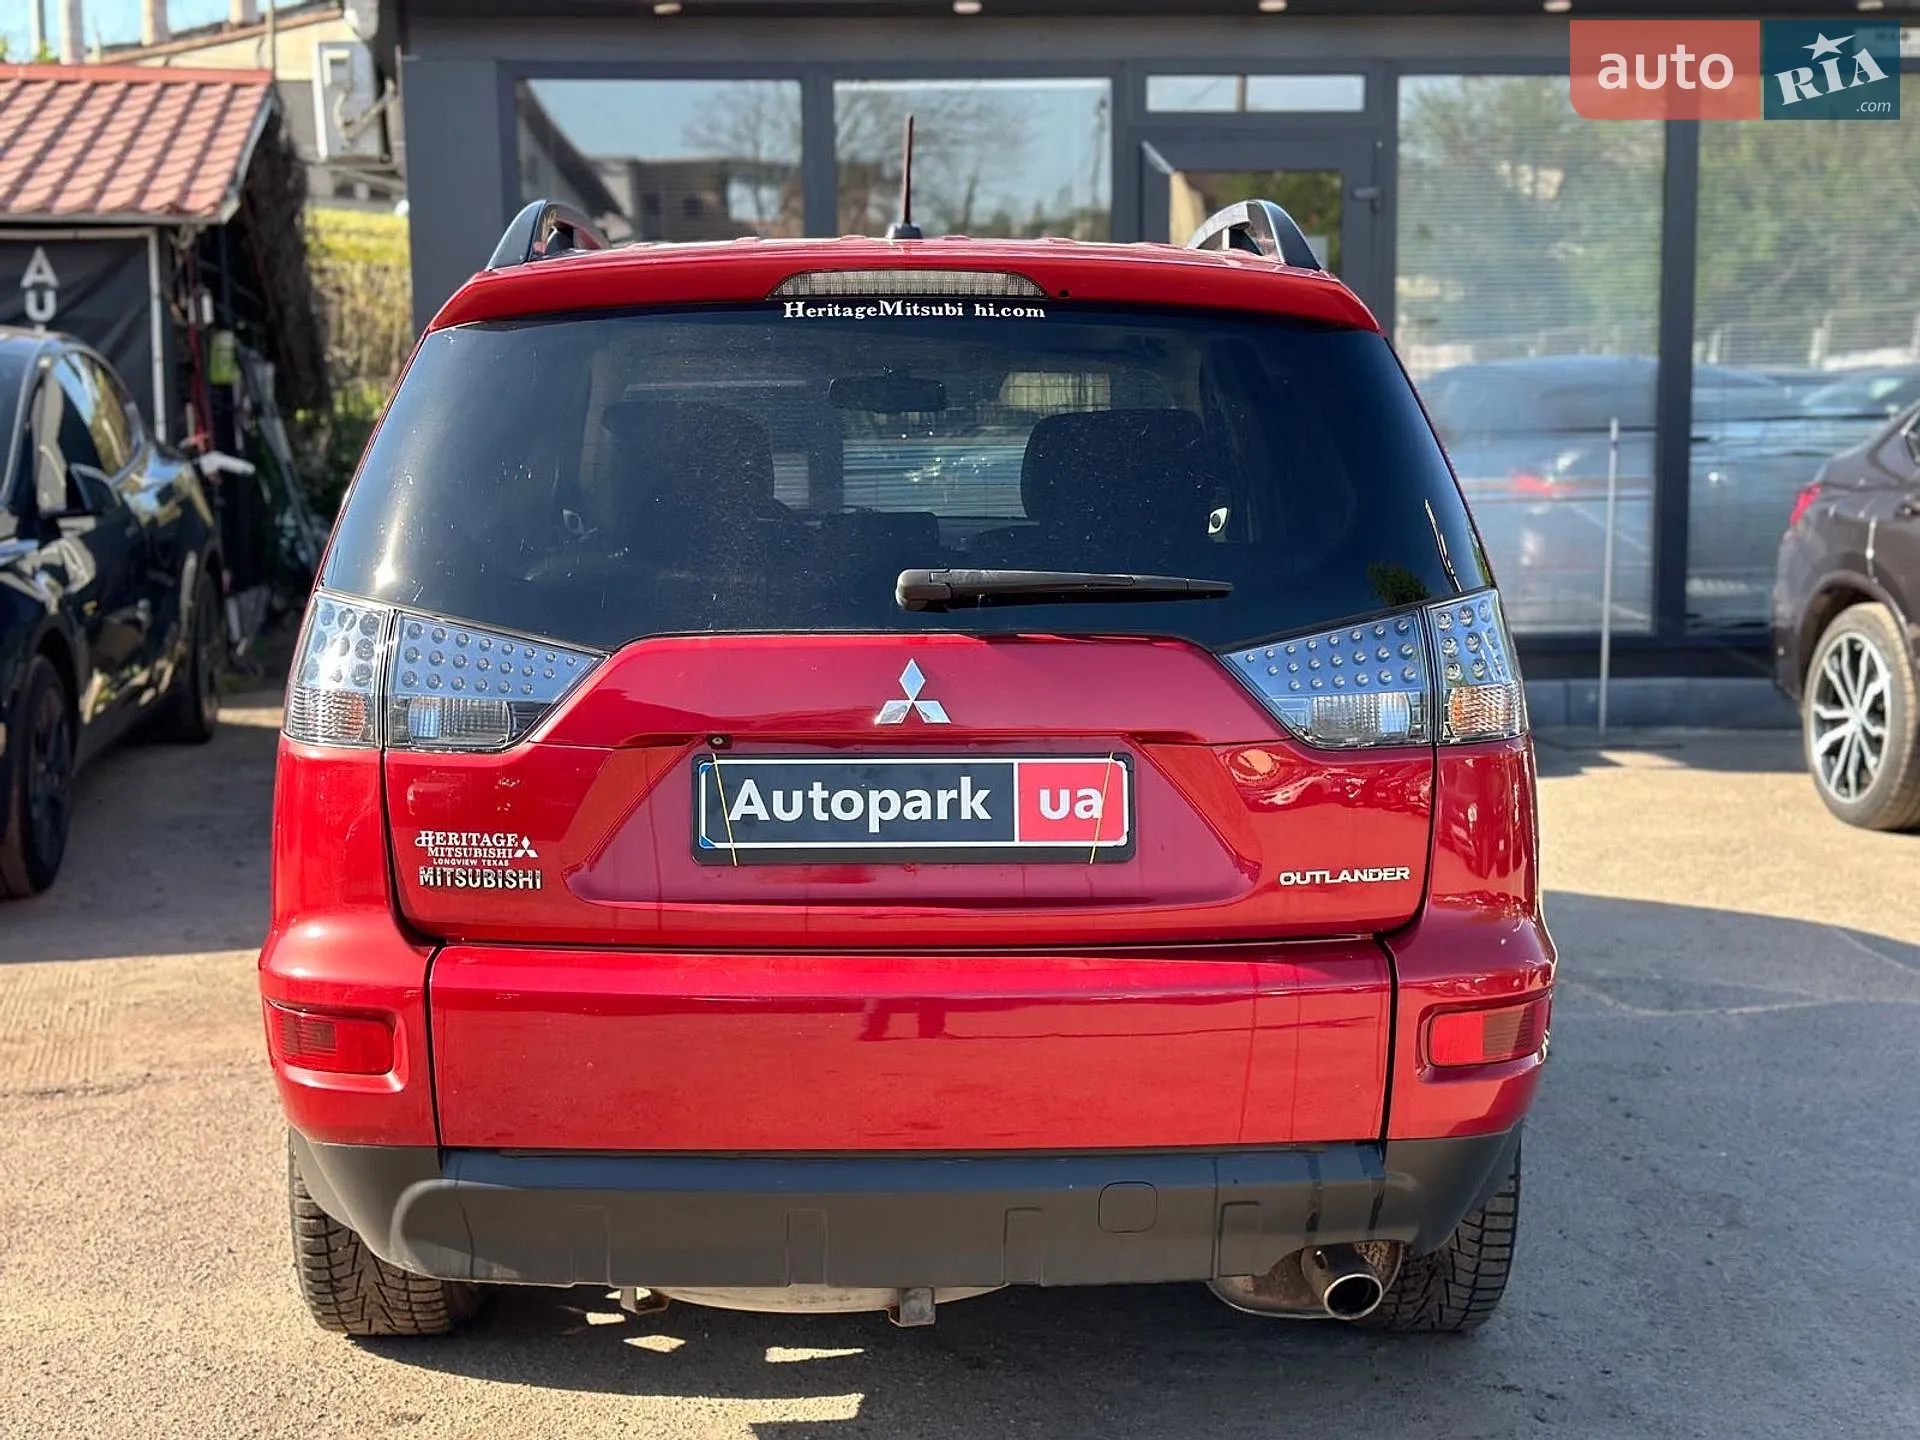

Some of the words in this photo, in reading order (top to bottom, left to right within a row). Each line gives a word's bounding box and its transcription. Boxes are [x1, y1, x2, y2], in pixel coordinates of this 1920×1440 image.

[728, 776, 992, 833] Autopark
[1038, 787, 1103, 820] ua
[415, 830, 519, 848] HERITAGE
[428, 847, 513, 859] MITSUBISHI
[433, 857, 478, 866] LONGVIEW
[481, 859, 509, 867] TEXAS
[419, 866, 542, 890] MITSUBISHI
[1279, 866, 1411, 886] OUTLANDER
